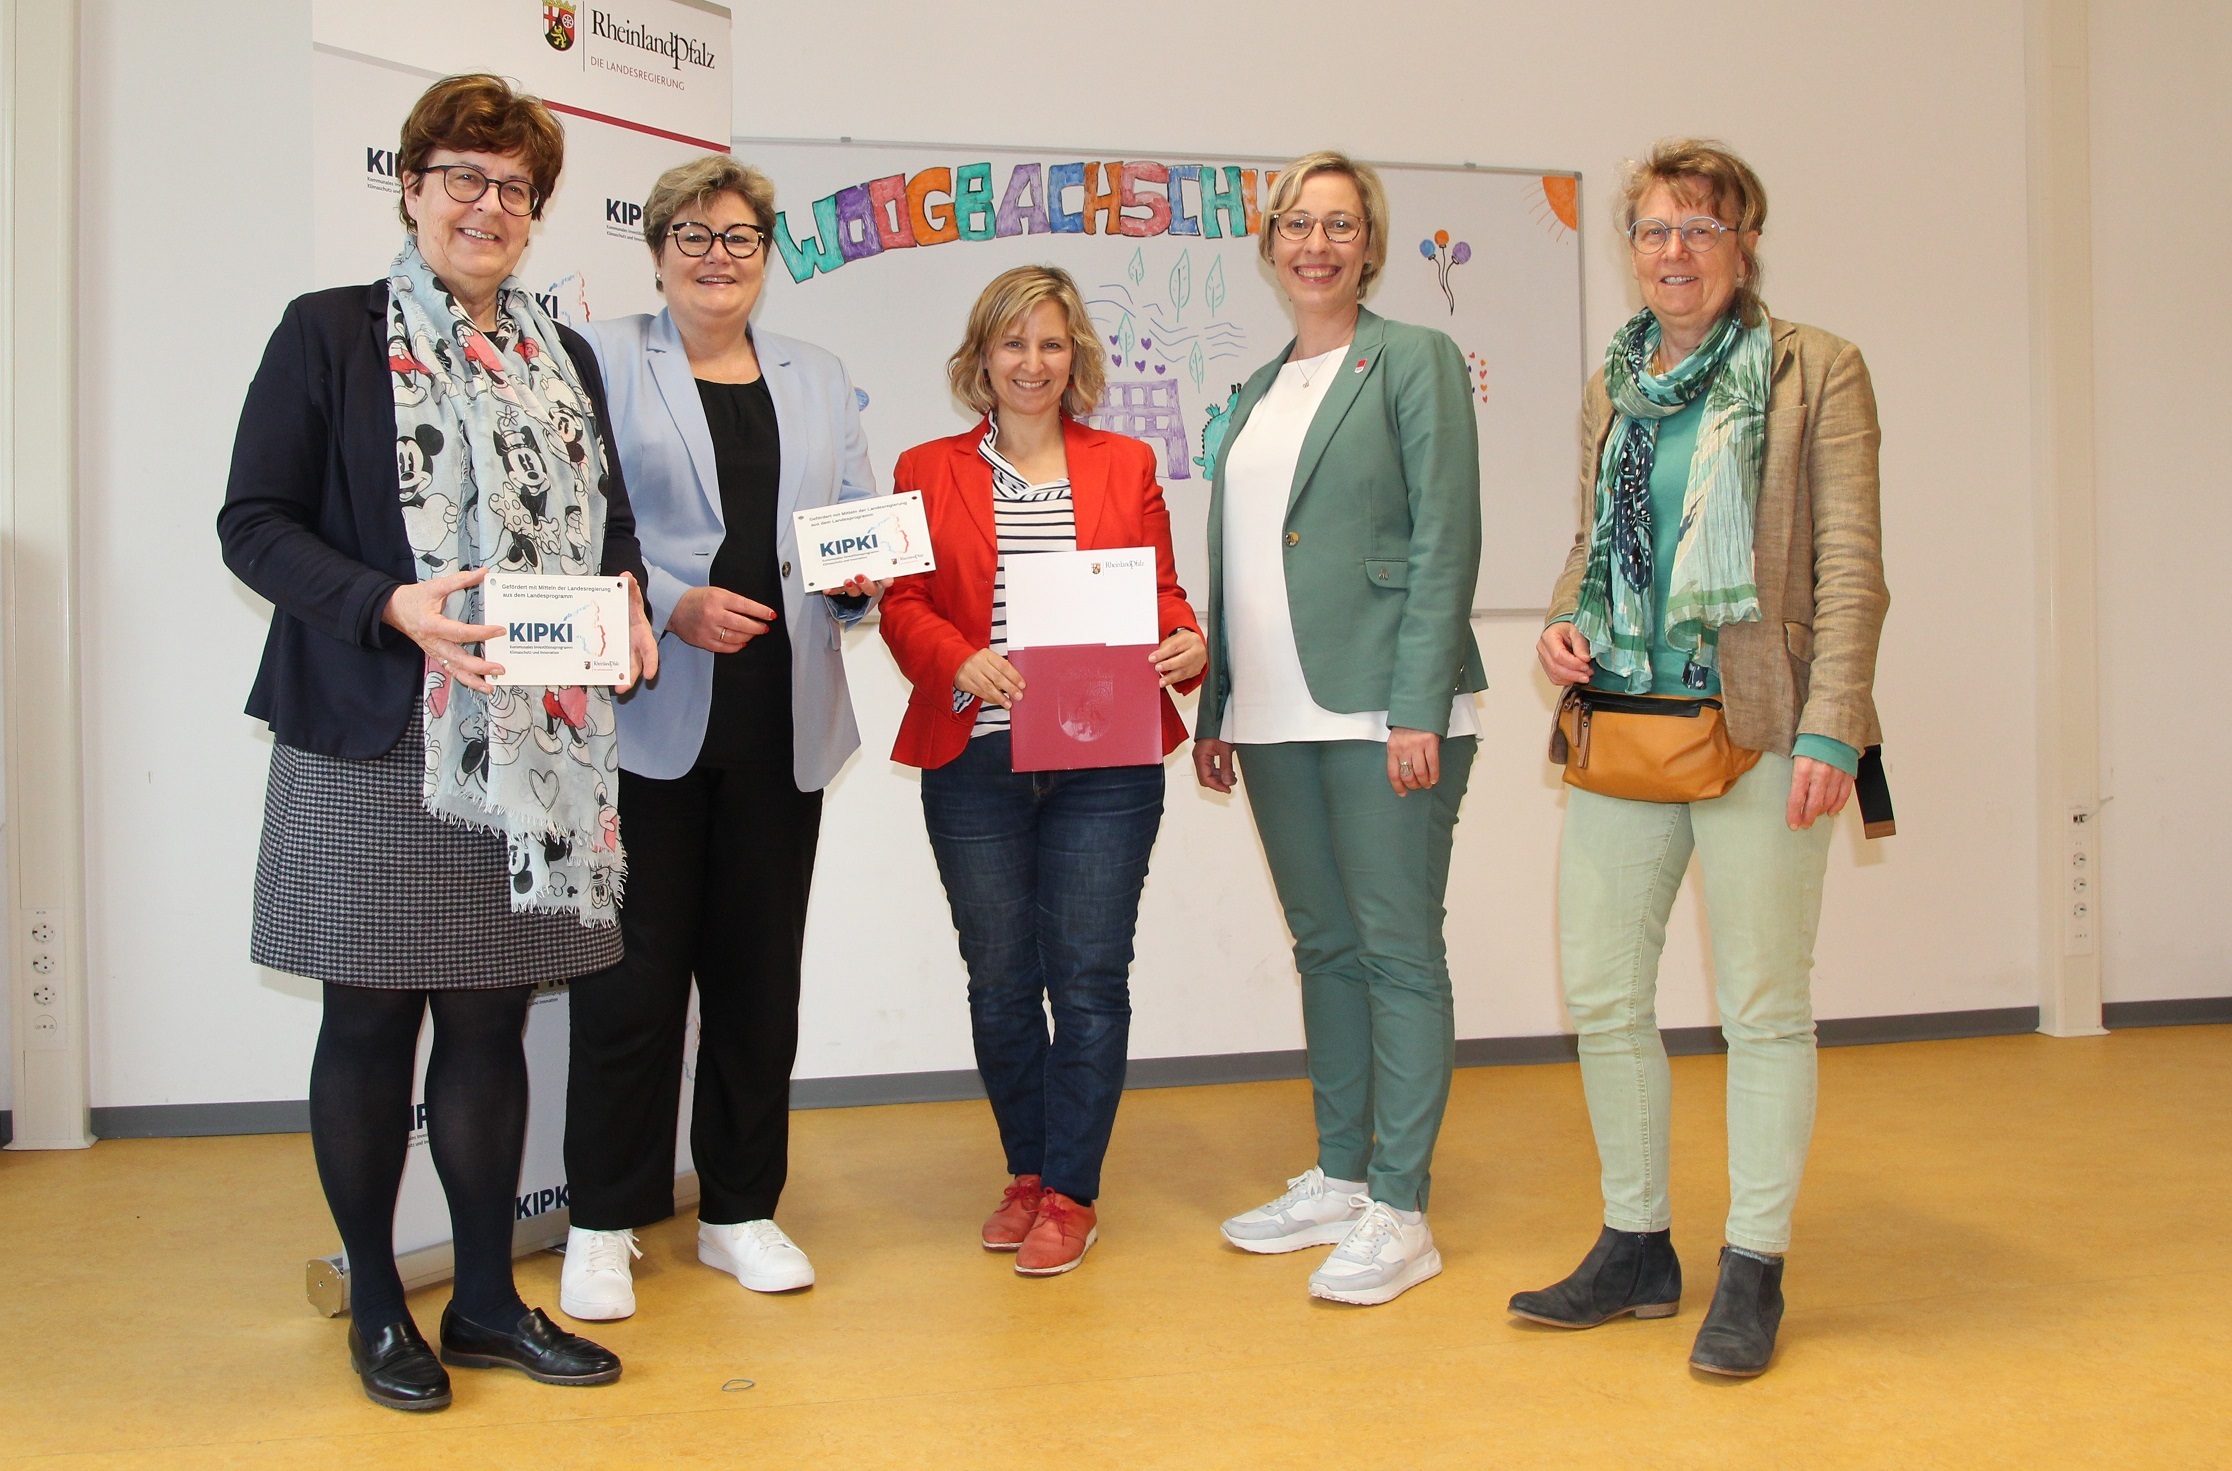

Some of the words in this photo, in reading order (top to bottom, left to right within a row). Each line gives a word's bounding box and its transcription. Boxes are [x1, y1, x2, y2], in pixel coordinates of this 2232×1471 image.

[590, 55, 604, 69] DIE
[606, 60, 685, 91] LANDESREGIERUNG
[367, 146, 400, 178] KI
[606, 198, 644, 226] KIP
[820, 534, 878, 557] KIPKI
[509, 622, 573, 643] KIPKI
